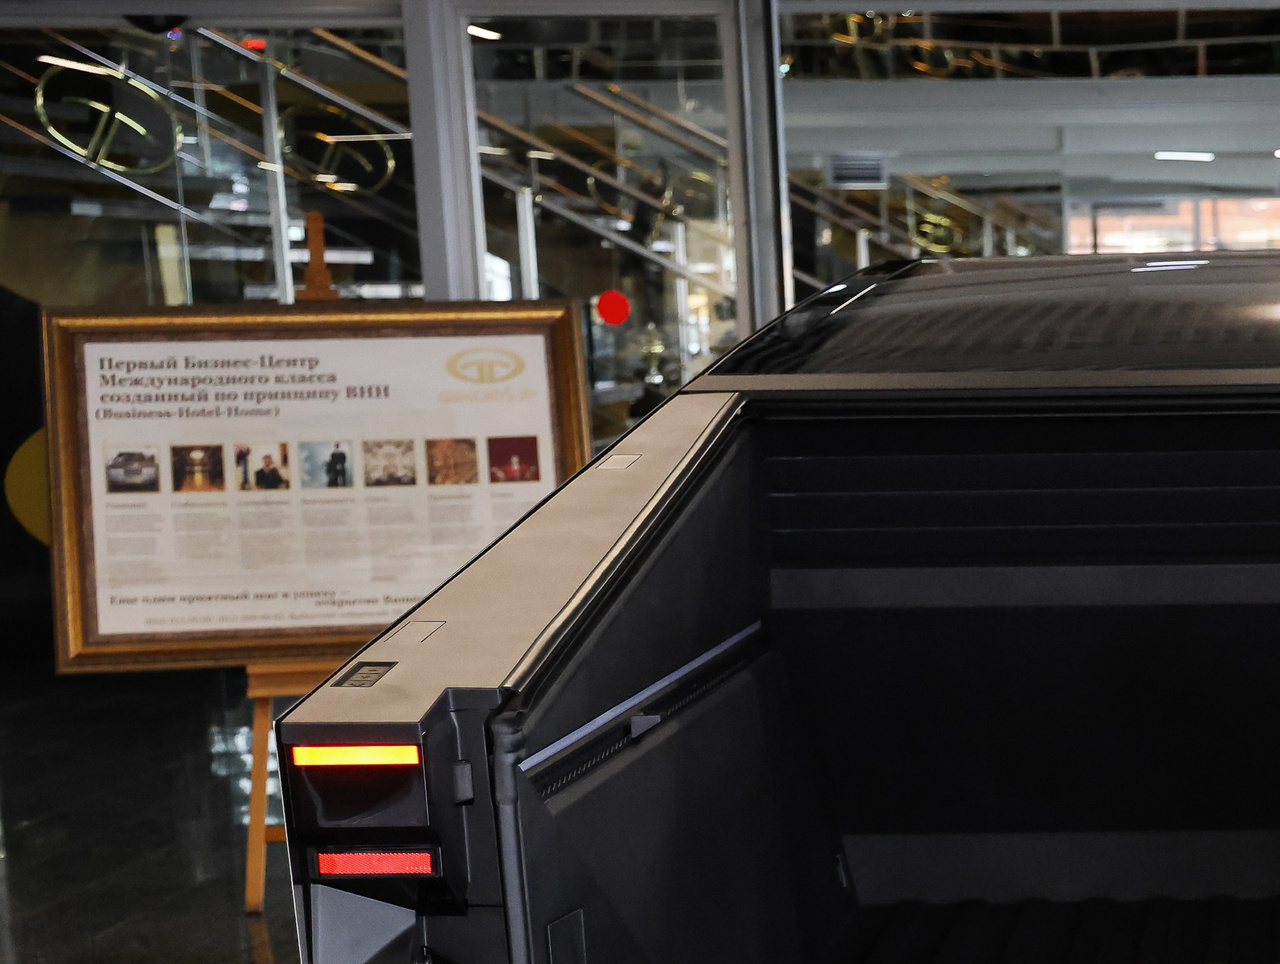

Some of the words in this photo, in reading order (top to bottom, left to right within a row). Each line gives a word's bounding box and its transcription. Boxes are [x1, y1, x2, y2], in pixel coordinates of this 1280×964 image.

[100, 356, 177, 374] Первый
[100, 374, 269, 390] Международного
[275, 373, 337, 384] класса
[100, 389, 209, 404] созданный
[215, 390, 238, 402] по
[243, 389, 338, 404] принципу
